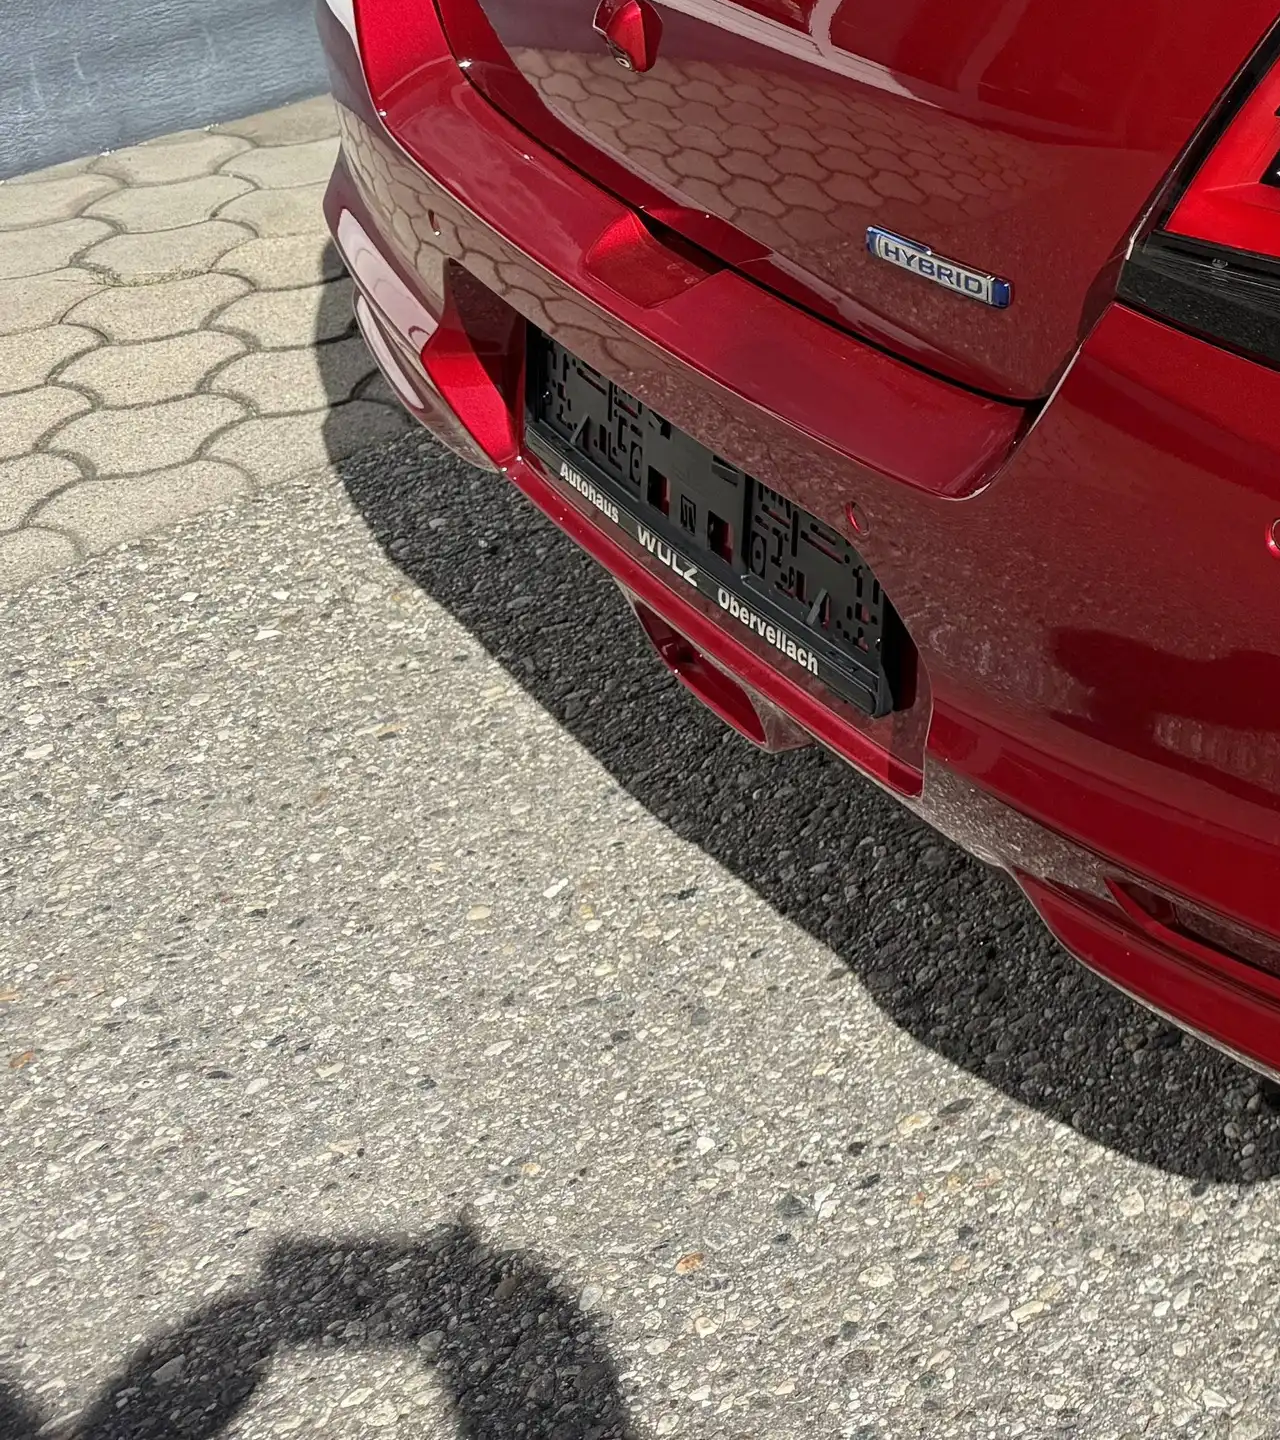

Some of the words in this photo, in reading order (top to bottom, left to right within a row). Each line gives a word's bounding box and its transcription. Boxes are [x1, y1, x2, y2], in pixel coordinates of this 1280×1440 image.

[883, 241, 983, 295] HYBRID
[559, 461, 620, 524] Autohaus
[637, 524, 698, 588] WULZ
[717, 587, 819, 676] Obervellach
